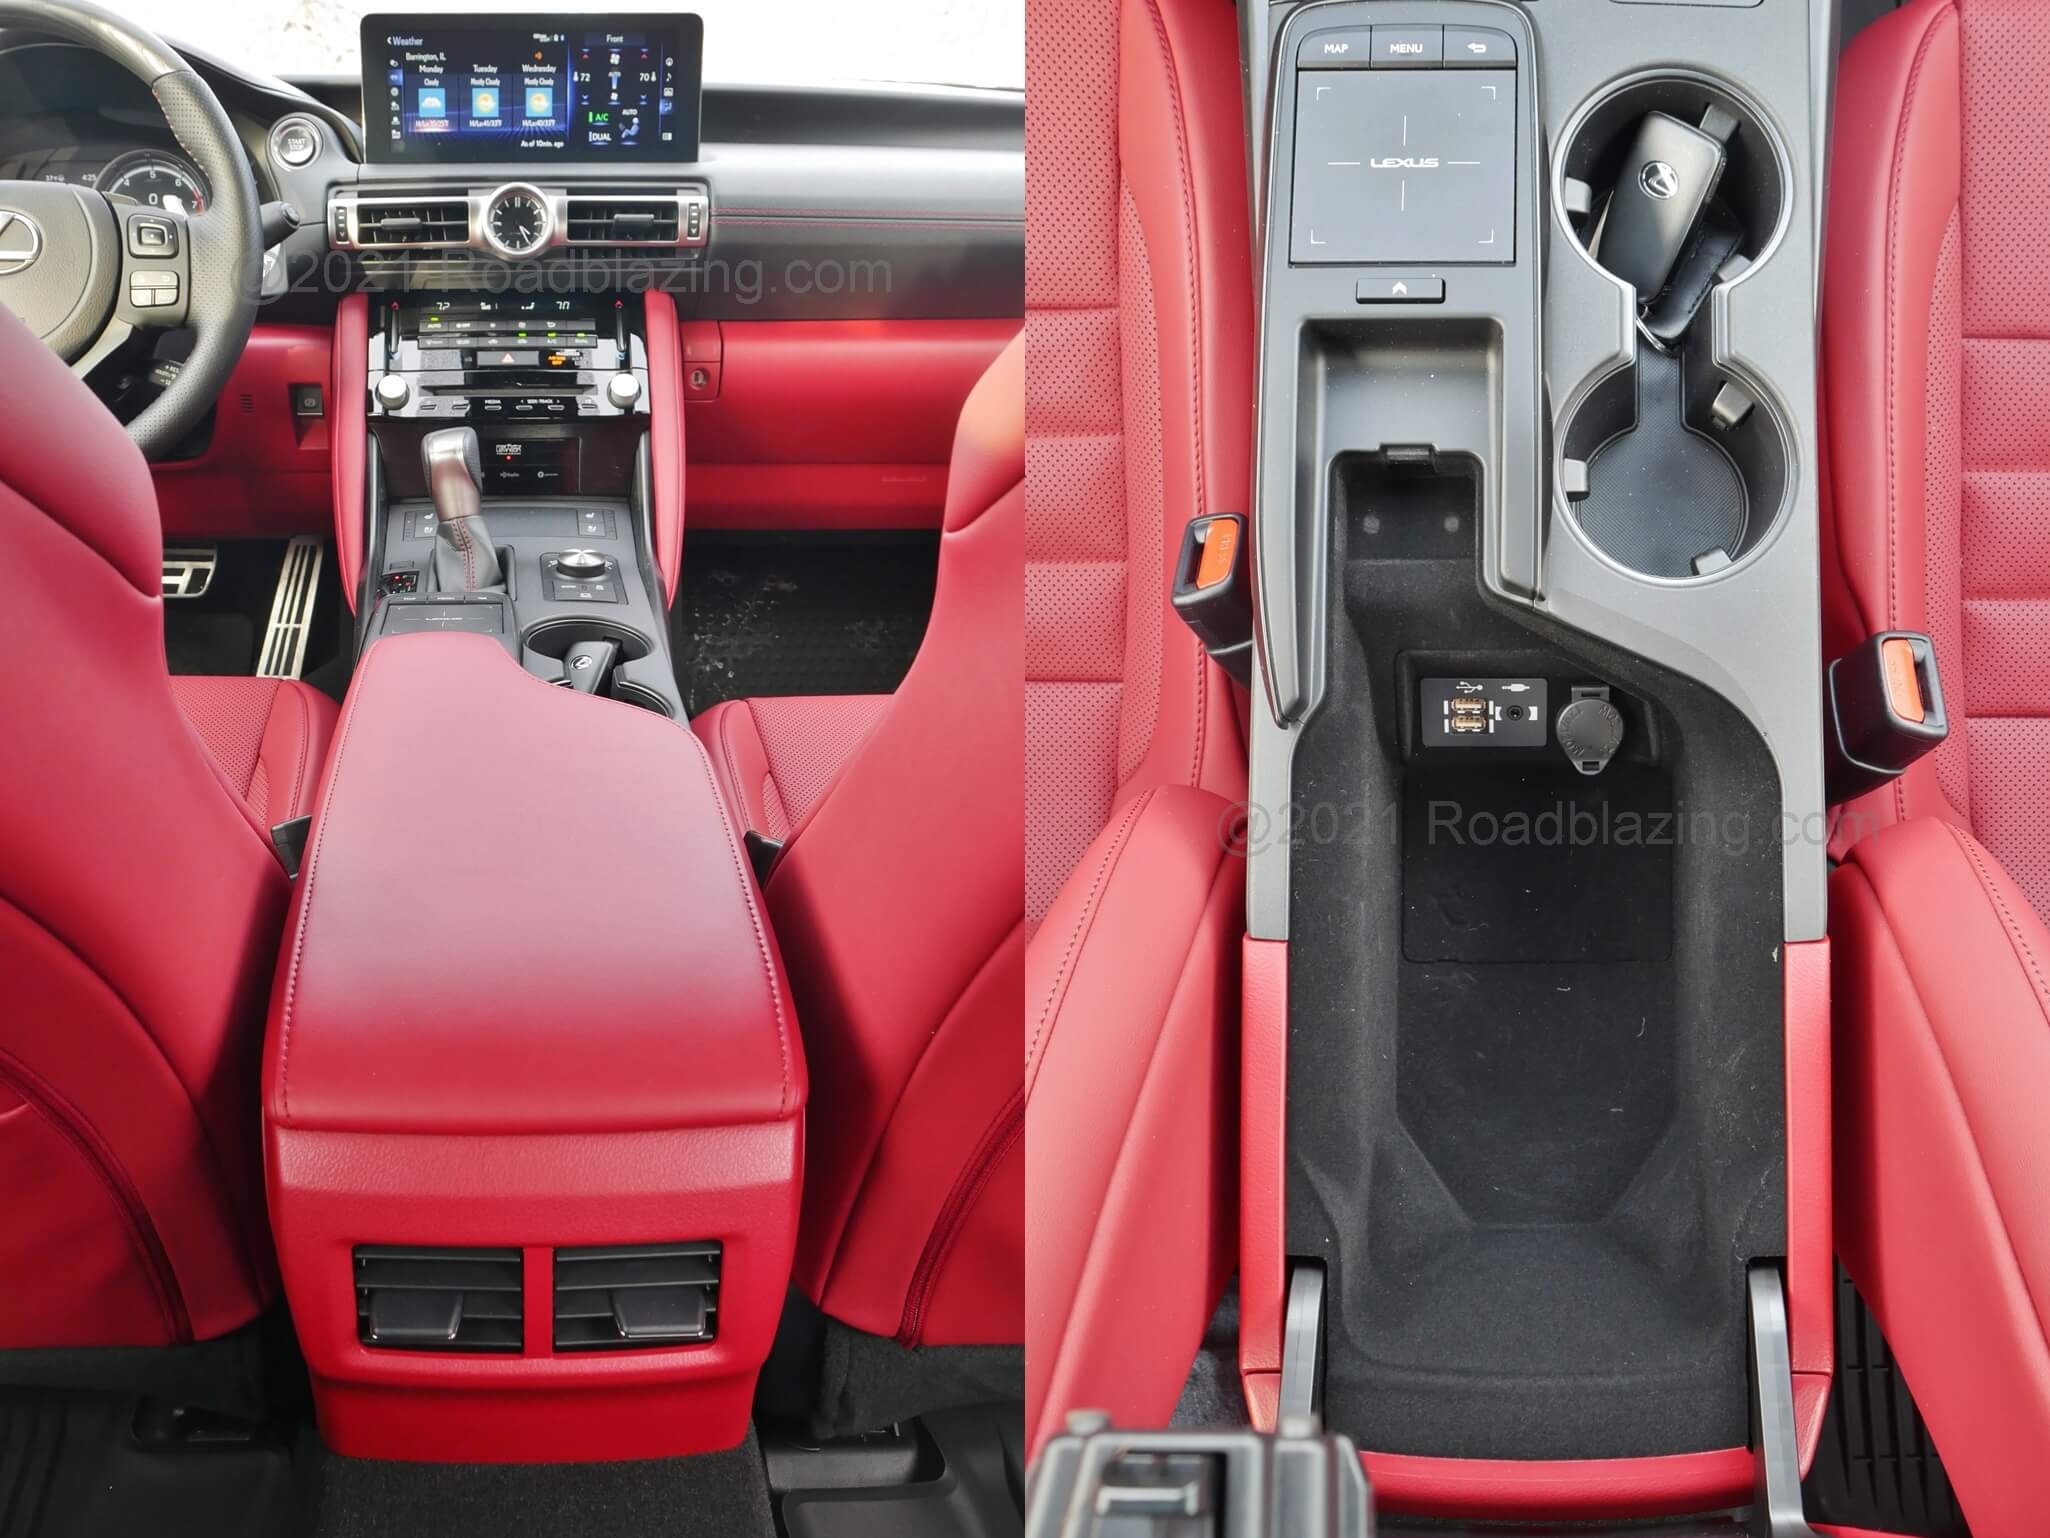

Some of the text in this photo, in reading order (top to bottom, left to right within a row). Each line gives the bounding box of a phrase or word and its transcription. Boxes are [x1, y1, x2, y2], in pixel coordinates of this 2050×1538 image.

[392, 36, 423, 47] Weather
[606, 34, 624, 43] Front
[1324, 43, 1349, 54] MAP
[1390, 43, 1423, 54] MENU
[418, 65, 444, 74] Monday
[472, 65, 498, 74] Tuesday
[521, 65, 557, 74] Wednesday
[579, 72, 591, 82] 72
[639, 72, 650, 82] 70
[595, 113, 609, 122] A/C
[1370, 157, 1440, 168] LEXUS
[149, 170, 157, 179] 5
[148, 192, 158, 205] 0
